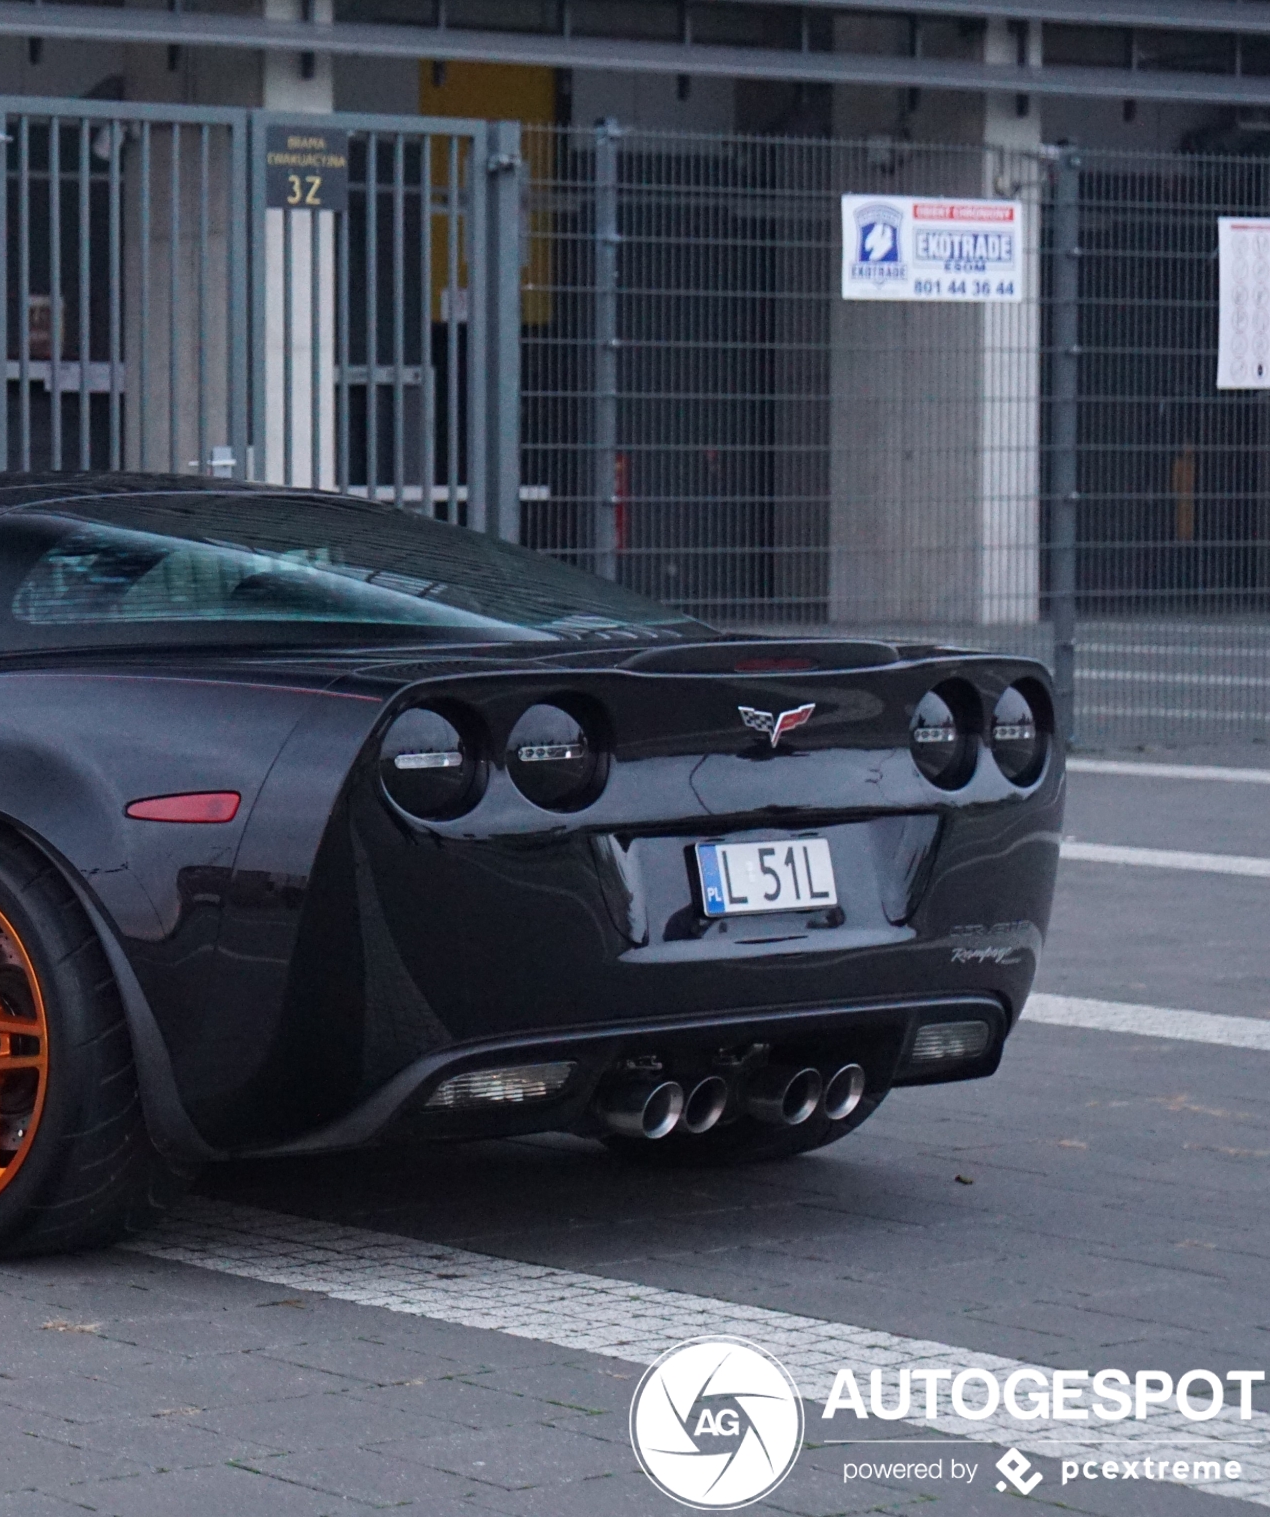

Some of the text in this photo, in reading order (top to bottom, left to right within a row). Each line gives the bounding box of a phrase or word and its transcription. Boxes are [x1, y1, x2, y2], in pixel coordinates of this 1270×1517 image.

[287, 174, 322, 205] 3Z
[916, 233, 1012, 260] EKOTRADE
[851, 266, 905, 279] EKOTRADE
[914, 280, 940, 295] 801
[948, 280, 966, 294] 44
[996, 282, 1014, 295] 44
[722, 846, 829, 904] L 51L
[707, 887, 722, 901] PL
